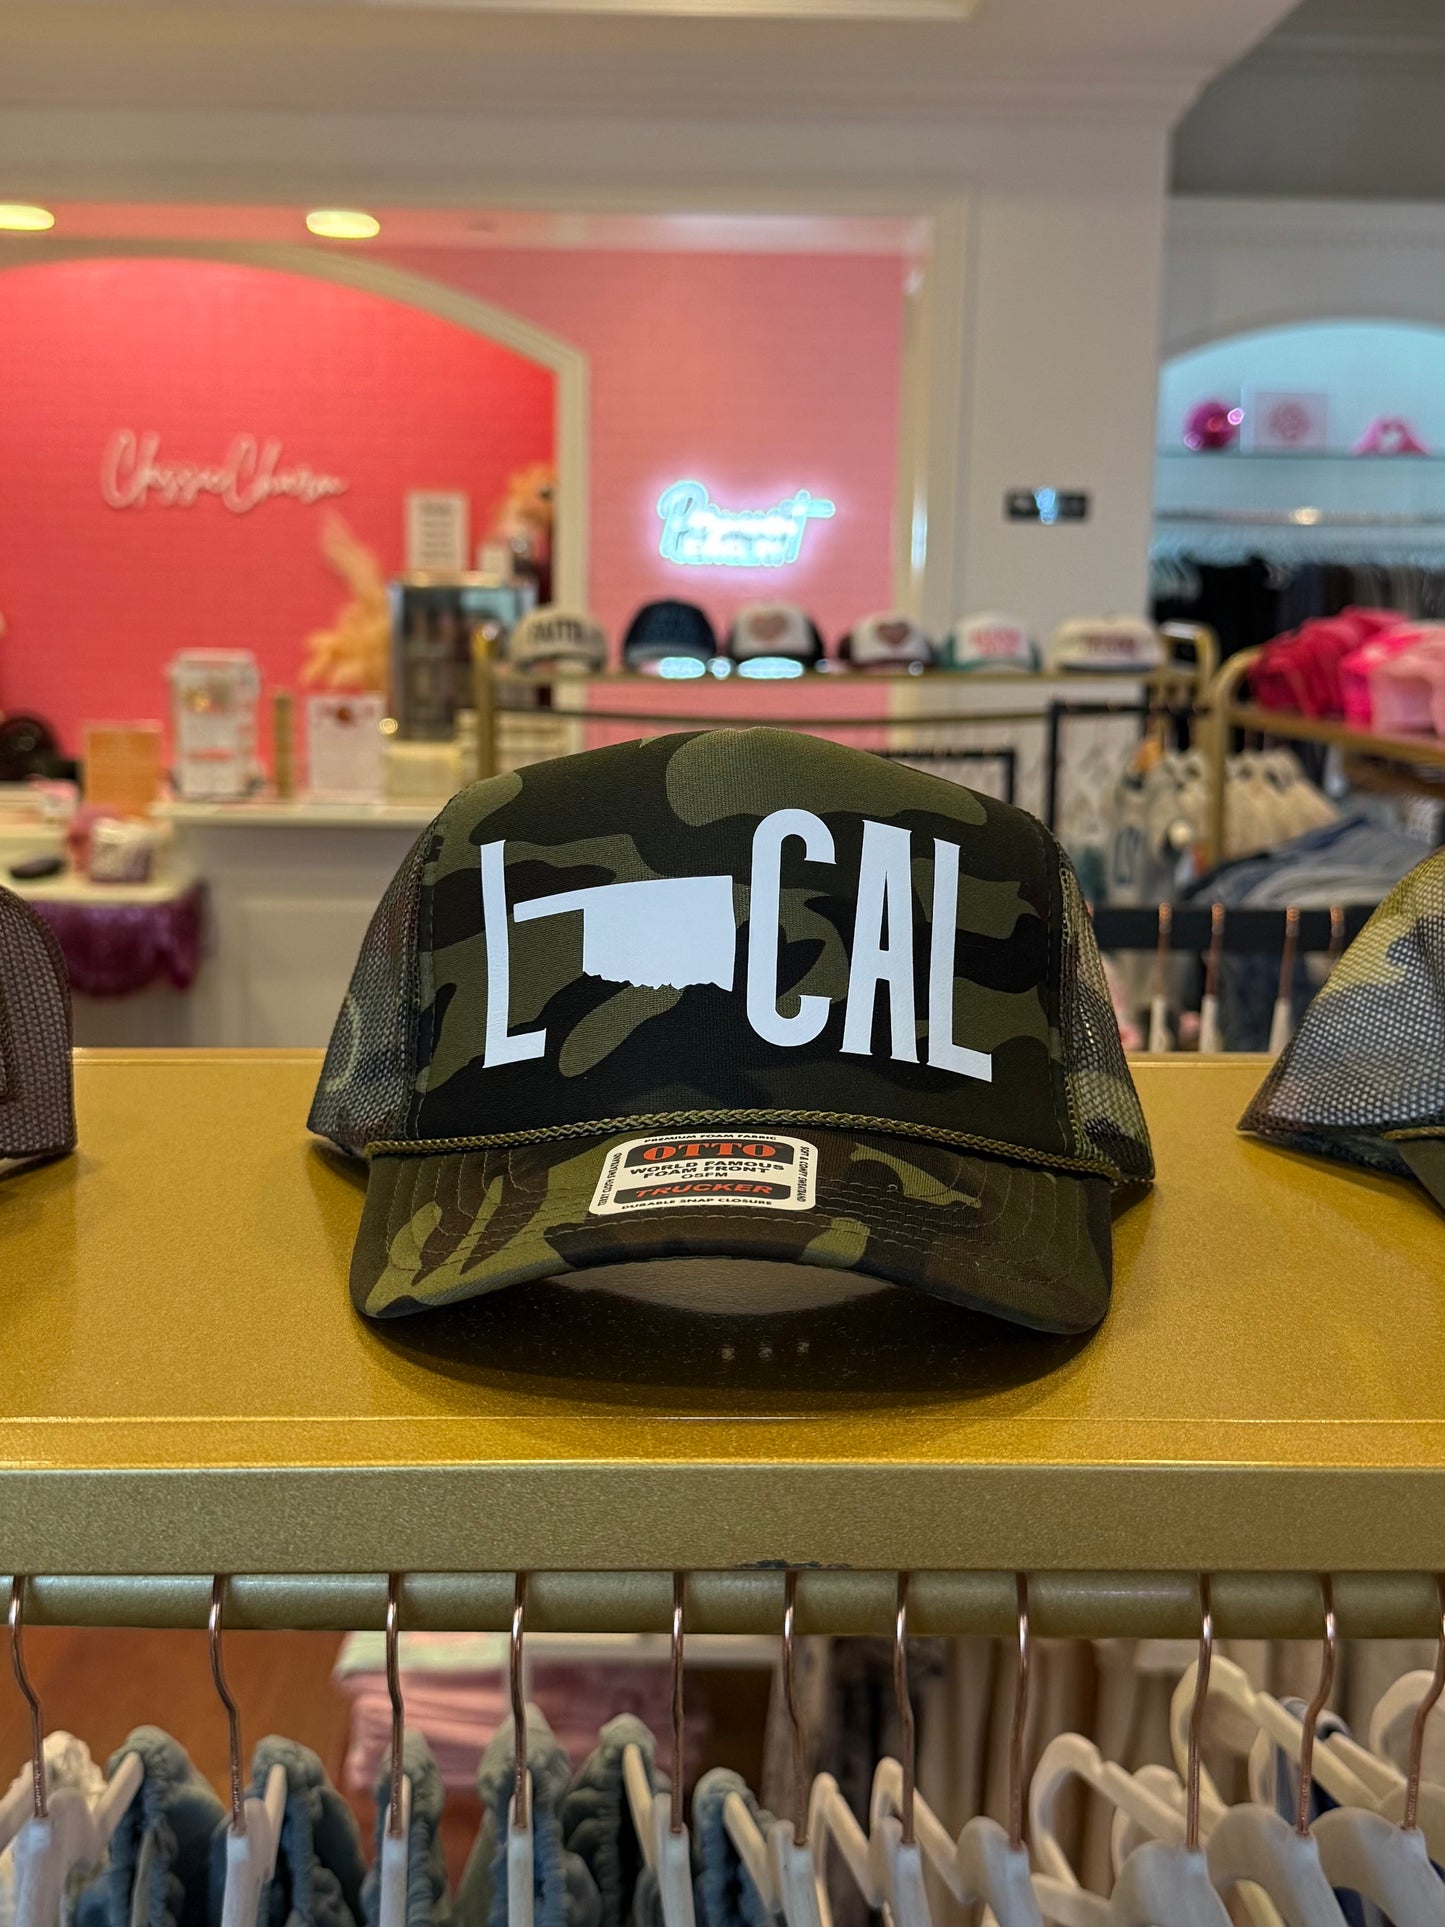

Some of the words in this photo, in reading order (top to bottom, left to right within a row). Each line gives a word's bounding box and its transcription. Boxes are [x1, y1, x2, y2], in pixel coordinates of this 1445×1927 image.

[644, 1134, 697, 1143] PREMIUM
[642, 1142, 776, 1161] OTTO
[630, 1161, 698, 1175] WORLD
[704, 1160, 785, 1171] FAMOUS
[643, 1167, 697, 1179] FOAM
[703, 1165, 770, 1173] FRONT
[636, 1183, 773, 1198] TRUCKER
[621, 1199, 676, 1209] DURABLE
